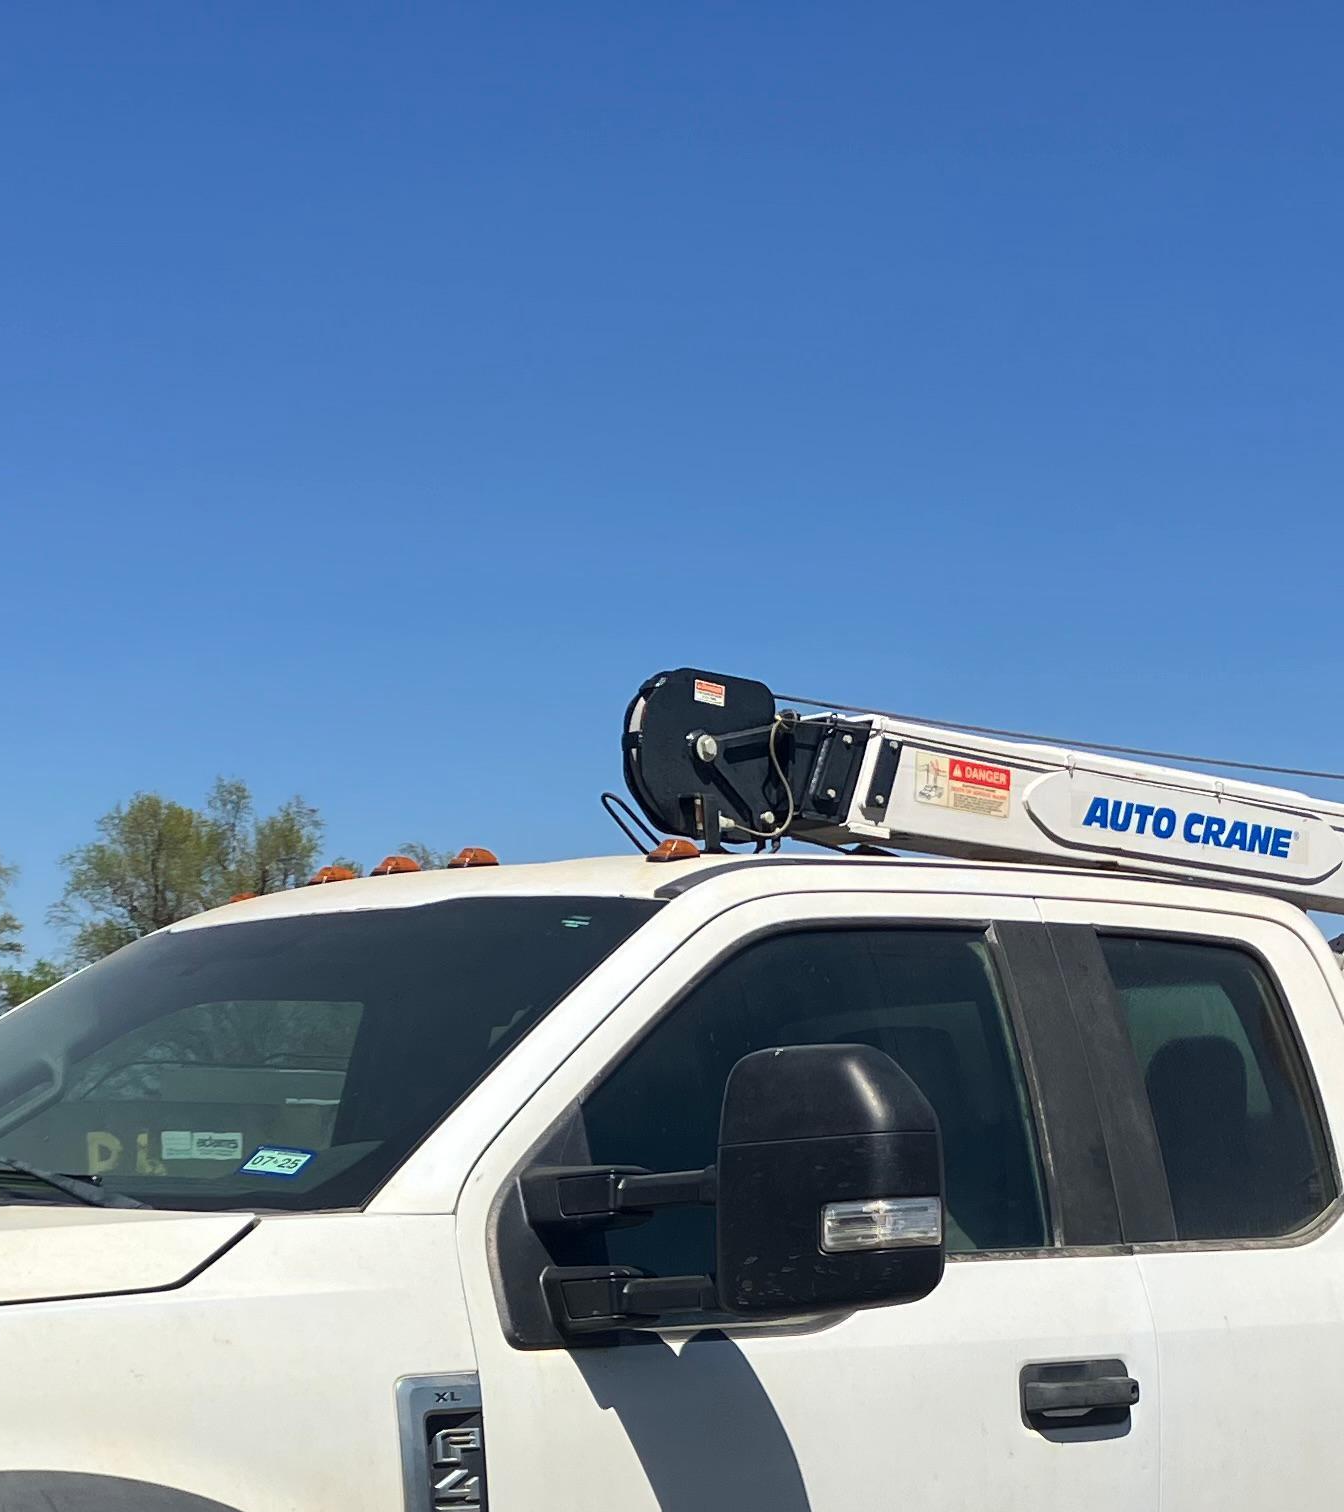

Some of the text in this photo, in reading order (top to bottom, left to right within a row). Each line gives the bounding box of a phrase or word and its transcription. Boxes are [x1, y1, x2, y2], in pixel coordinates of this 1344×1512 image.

[964, 766, 1007, 785] DANGER
[1082, 796, 1293, 859] AUTO CRANE
[251, 1155, 302, 1169] 07 25
[434, 1391, 462, 1403] XL
